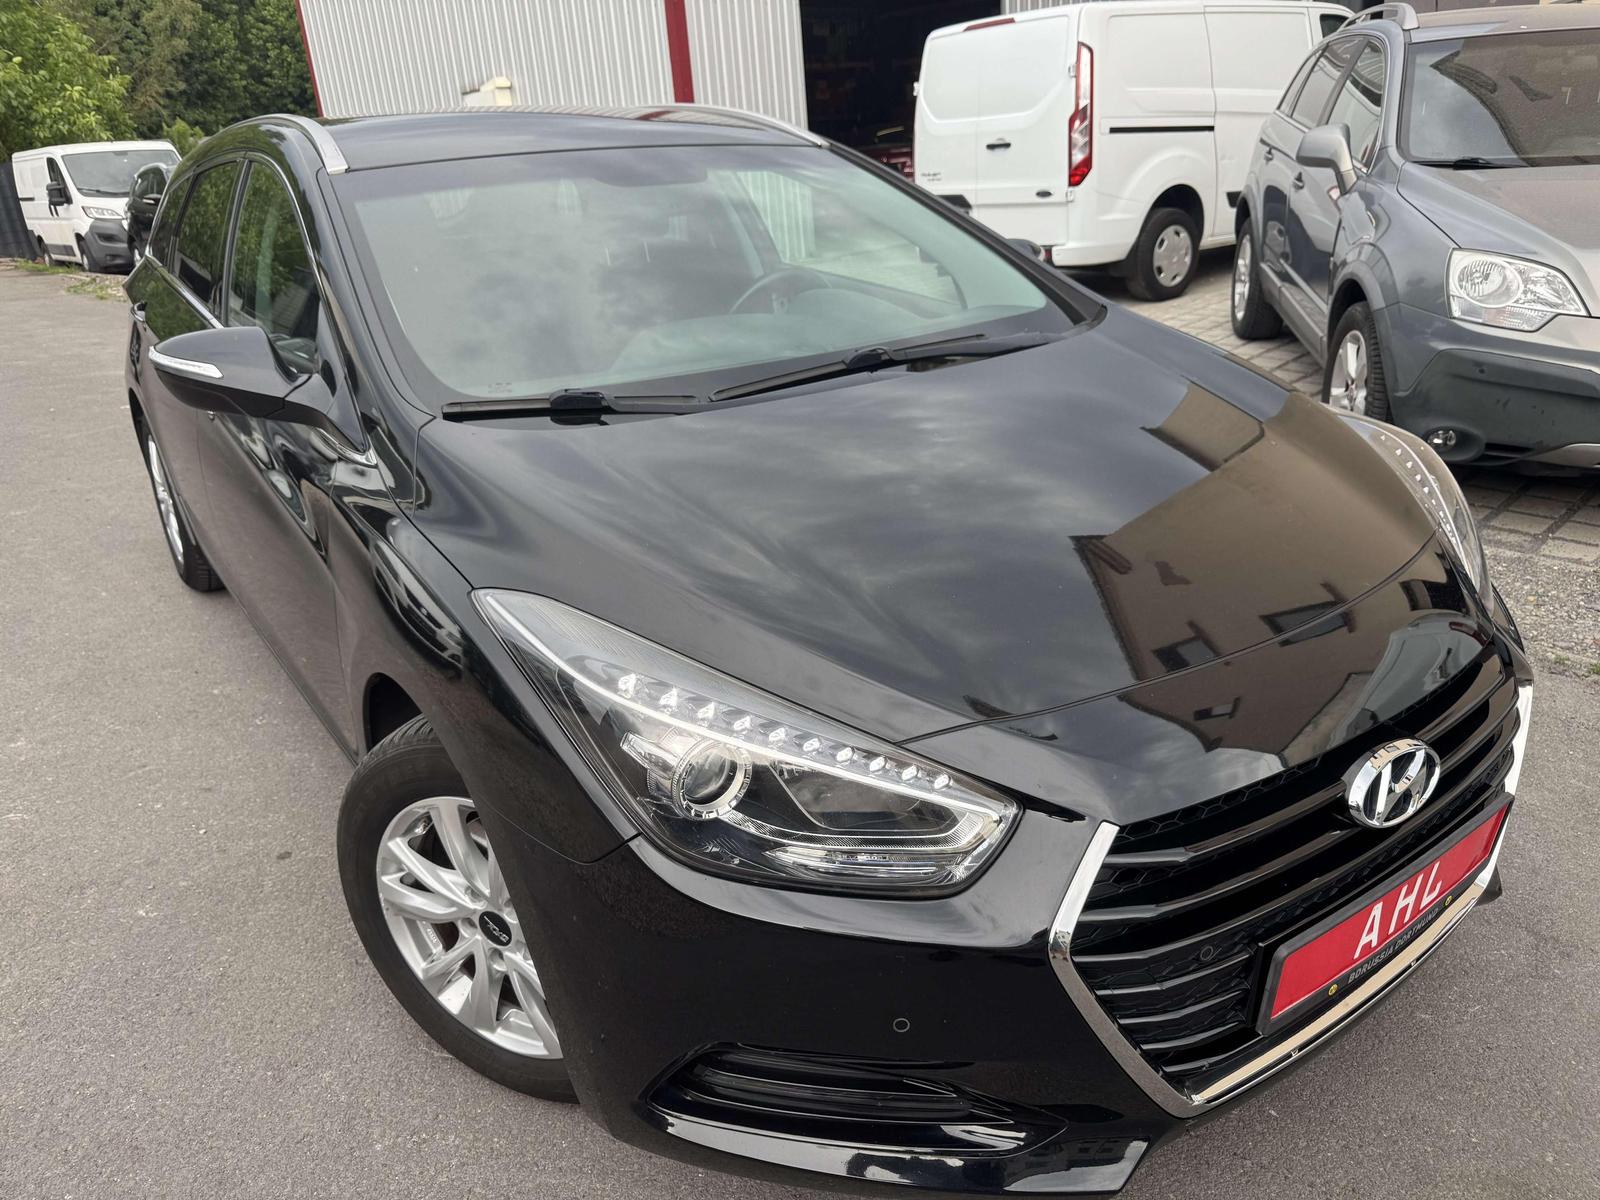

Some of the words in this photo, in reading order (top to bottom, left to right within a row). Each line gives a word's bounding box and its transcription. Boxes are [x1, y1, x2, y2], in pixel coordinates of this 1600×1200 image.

[1347, 946, 1394, 984] BORUSSIA
[1395, 908, 1439, 949] DORTMUND
[1353, 861, 1443, 960] AHL
